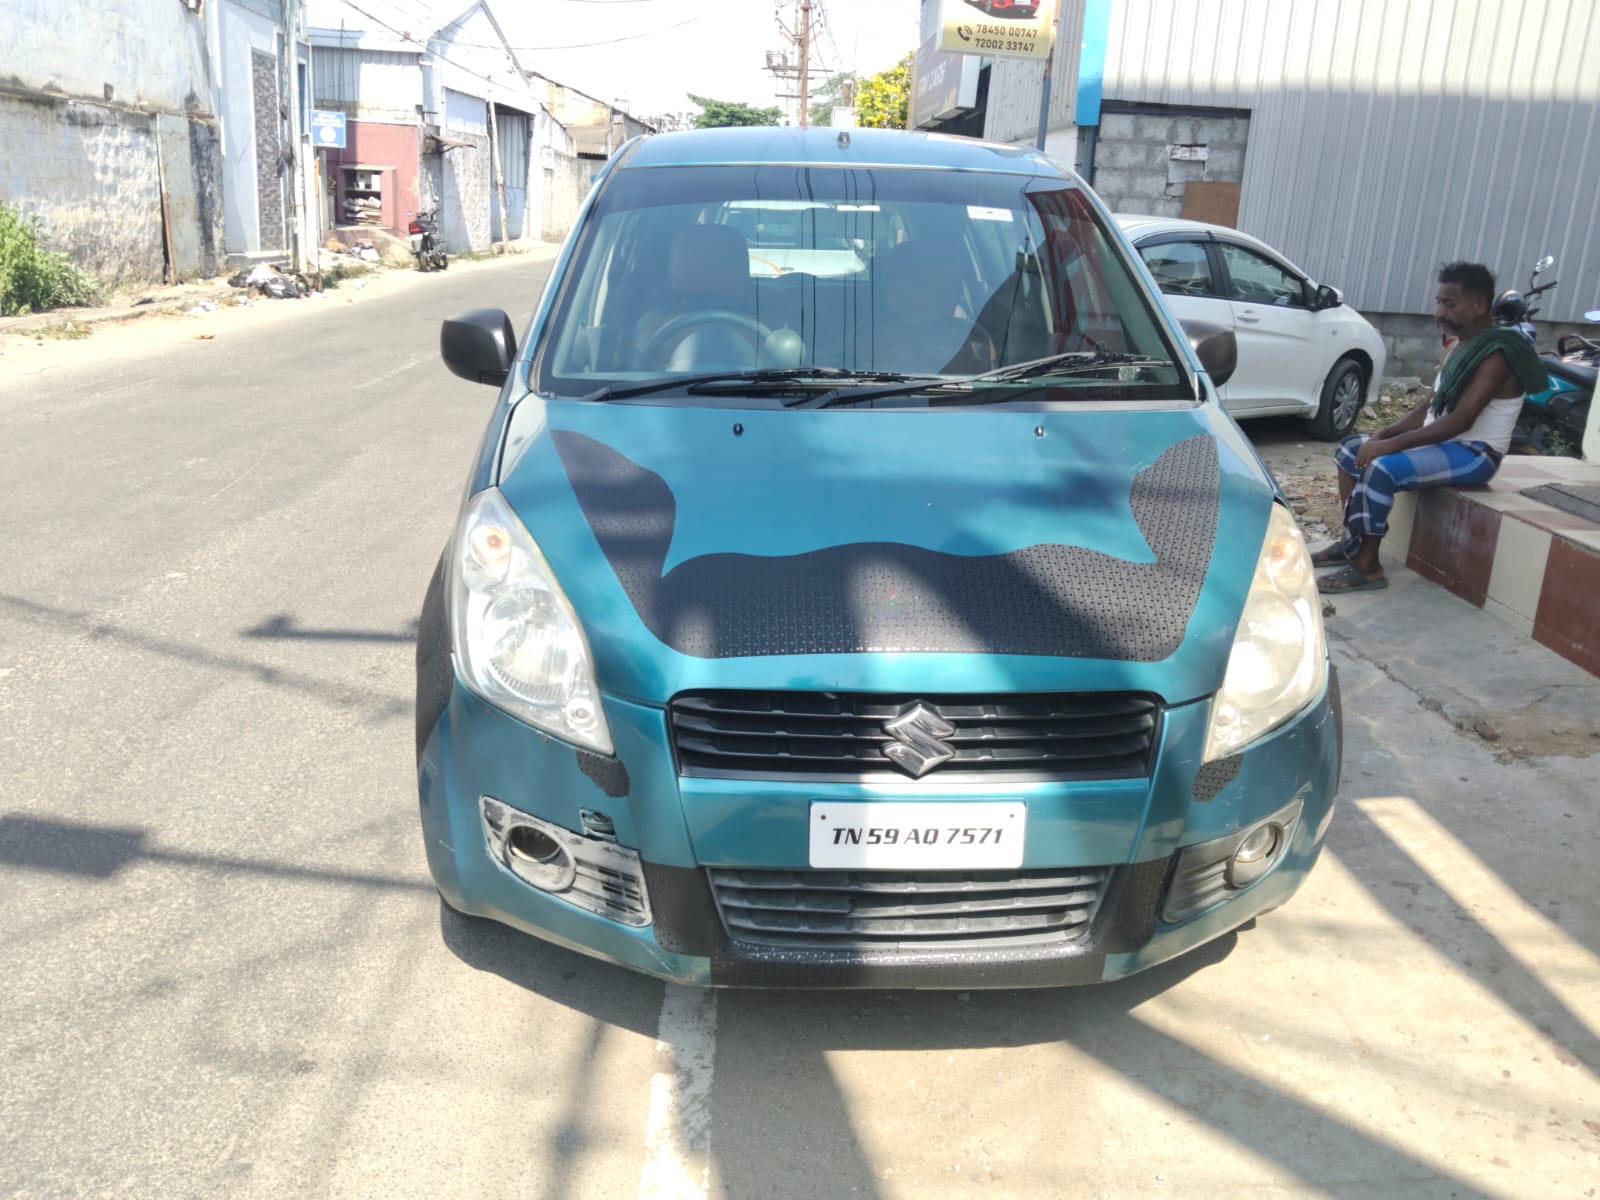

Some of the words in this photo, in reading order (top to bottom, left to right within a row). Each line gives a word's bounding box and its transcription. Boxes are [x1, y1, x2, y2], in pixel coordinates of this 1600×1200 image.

[976, 24, 1005, 36] 78450
[1008, 28, 1038, 39] 00747
[975, 38, 1003, 50] 72002
[1007, 41, 1034, 52] 33747
[832, 828, 863, 845] TN
[866, 828, 900, 845] 59
[904, 828, 939, 846] AQ
[947, 827, 1003, 845] 7571
